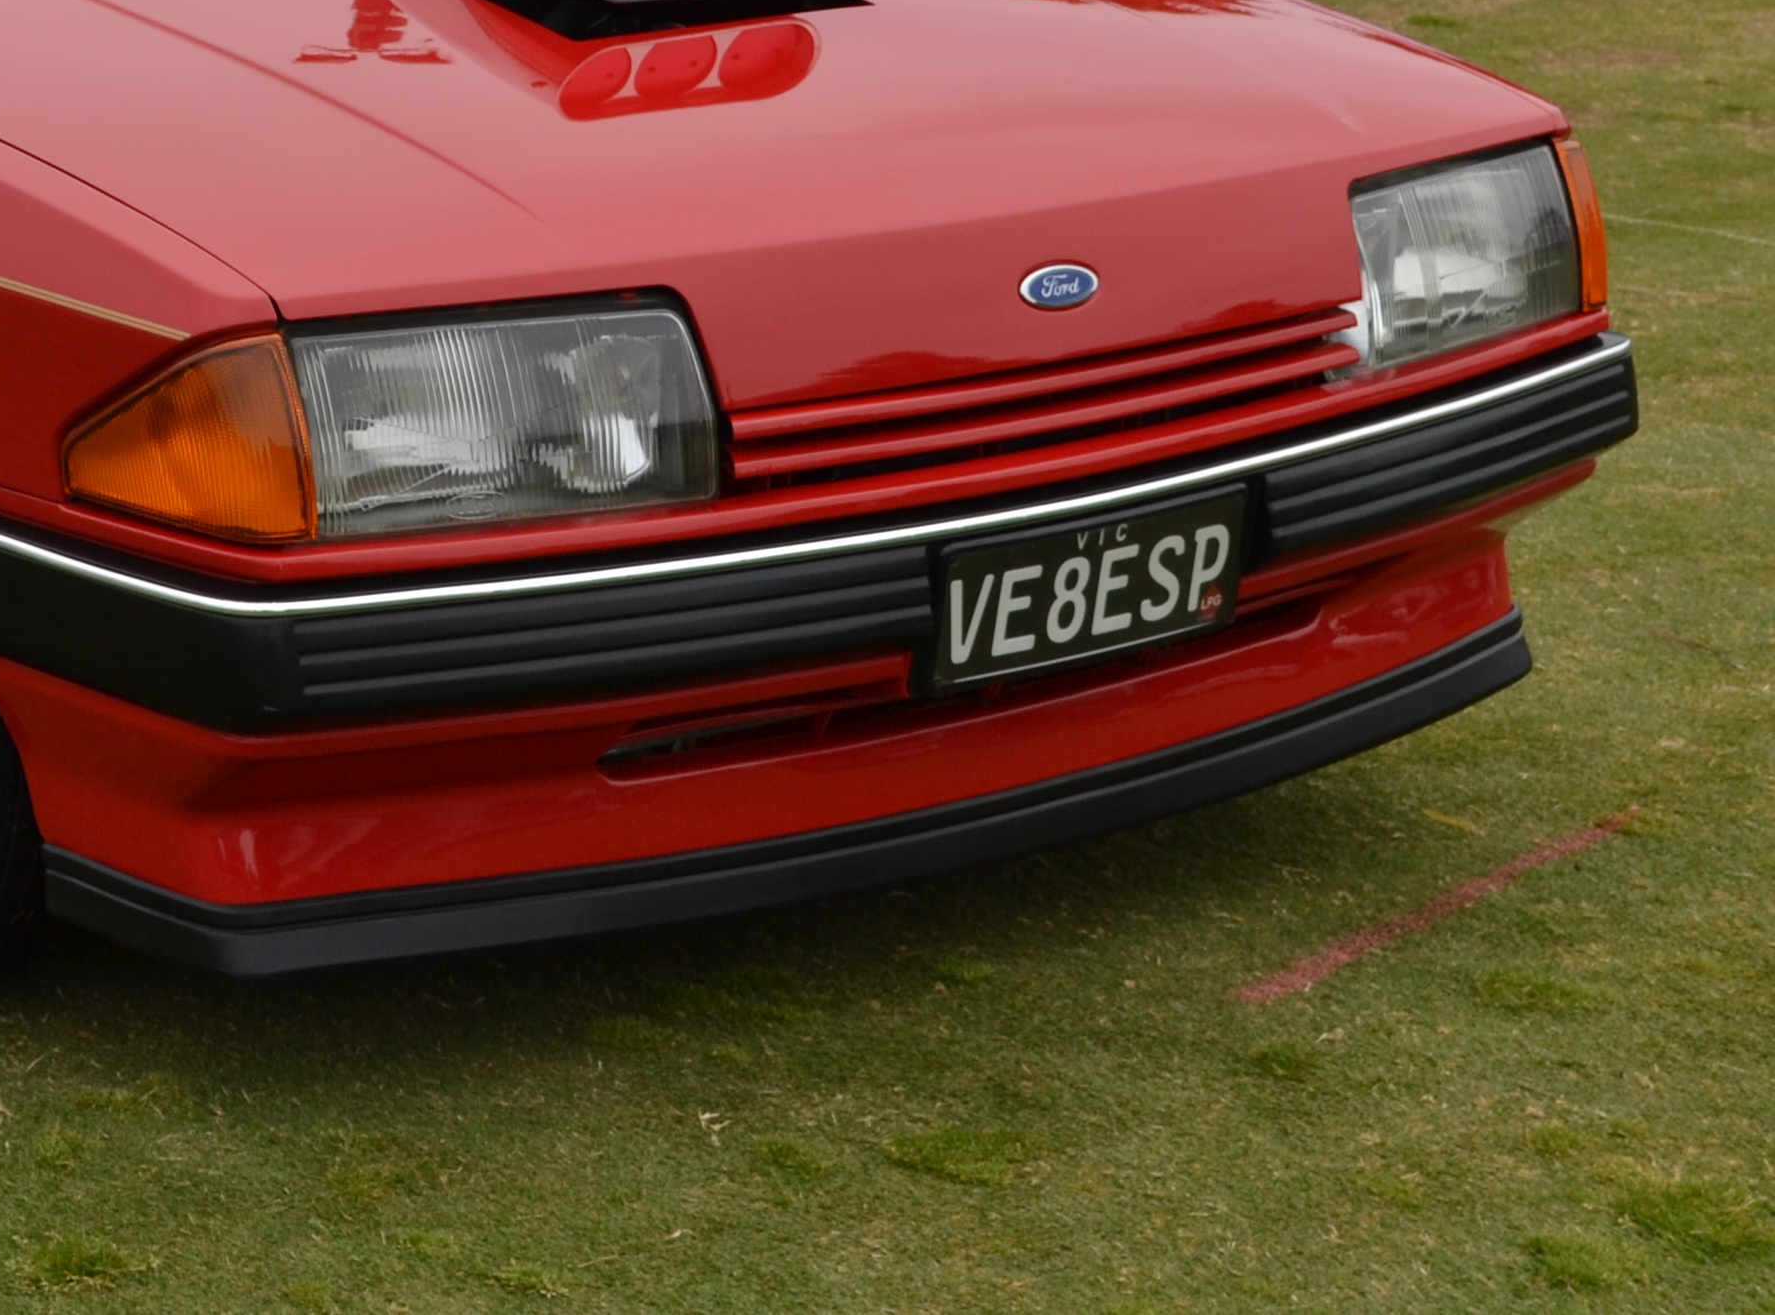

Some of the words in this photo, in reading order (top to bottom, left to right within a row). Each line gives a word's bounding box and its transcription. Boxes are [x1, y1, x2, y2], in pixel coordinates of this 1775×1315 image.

[1041, 274, 1080, 298] Ford
[1077, 523, 1128, 551] VIC
[950, 523, 1230, 665] VE8ESP
[1200, 593, 1222, 610] LPG
